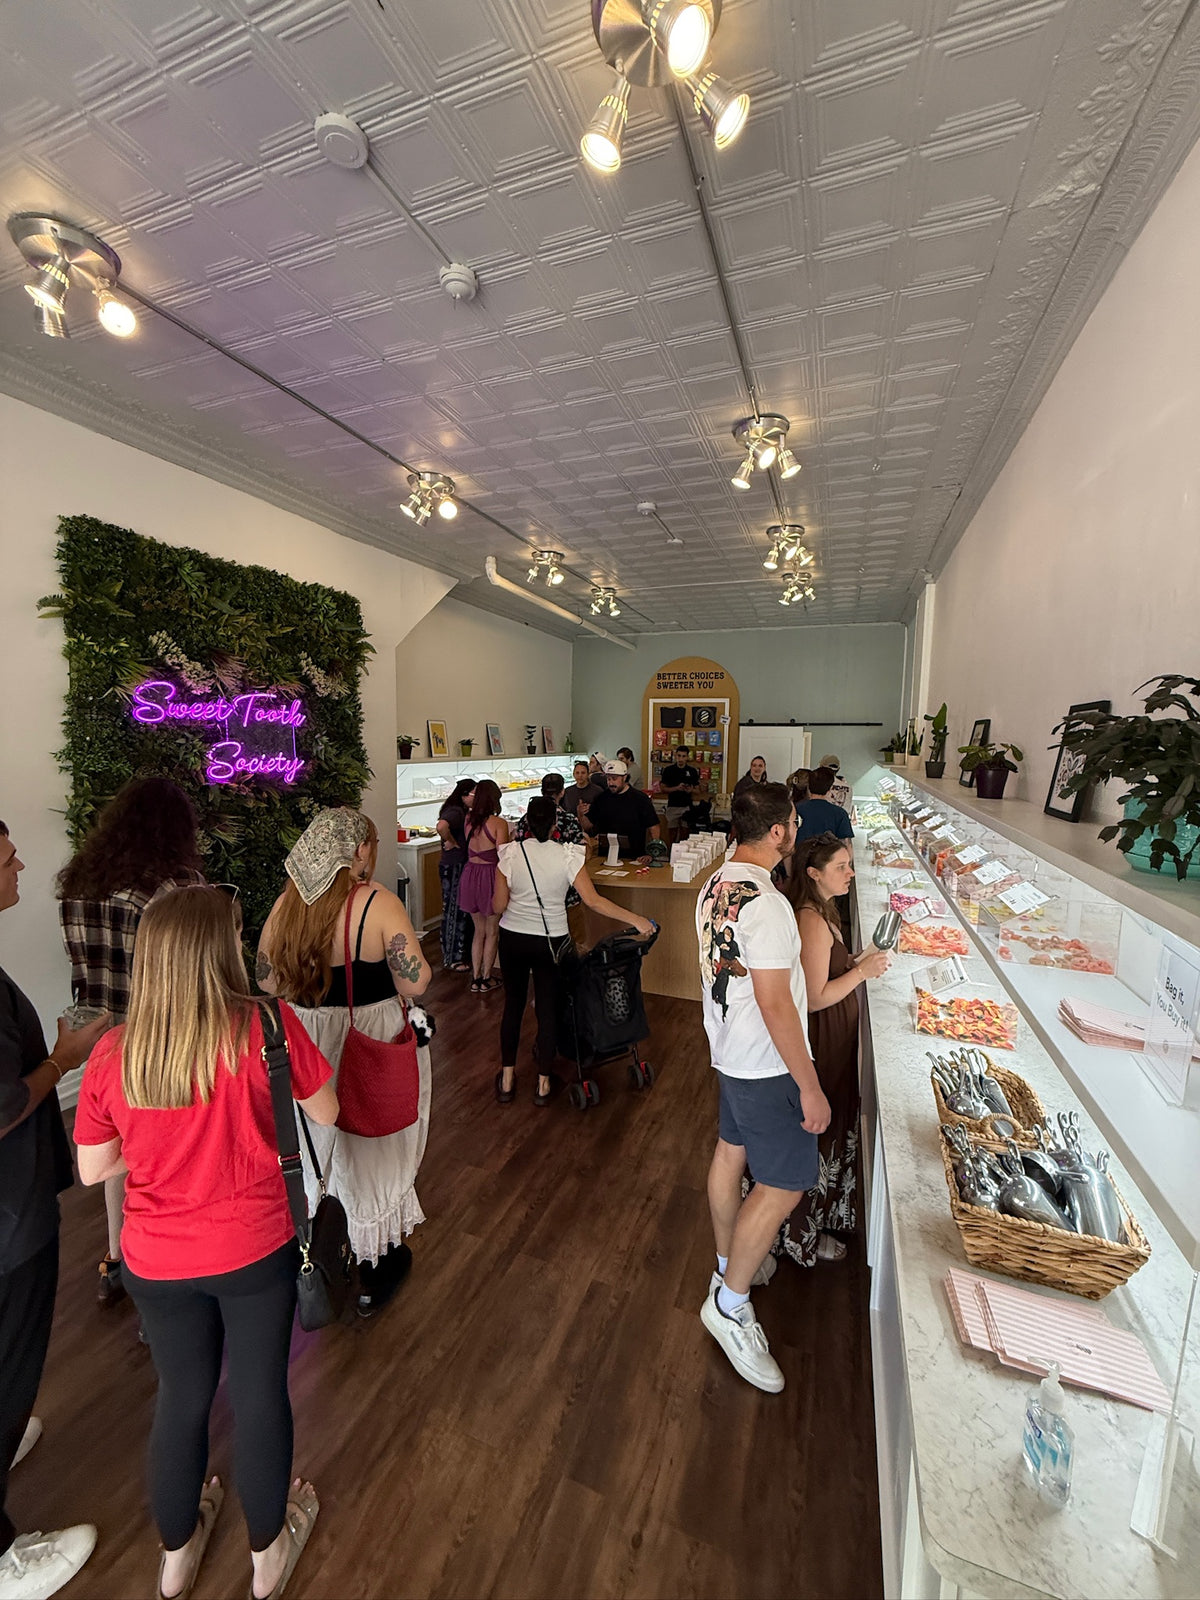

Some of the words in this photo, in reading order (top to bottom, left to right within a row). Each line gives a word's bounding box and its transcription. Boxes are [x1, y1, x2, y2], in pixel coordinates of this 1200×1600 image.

[657, 672, 687, 680] BETTER
[689, 672, 725, 680] CHOICES
[657, 681, 694, 689] SWEETER
[697, 681, 714, 689] YOU
[133, 681, 233, 723] Sweet
[233, 692, 306, 727] Tooth
[207, 740, 305, 783] Society
[1165, 976, 1178, 1000] Bag
[1157, 992, 1167, 1012] You
[1167, 1004, 1180, 1027] Buy
[1180, 1015, 1189, 1033] it!
